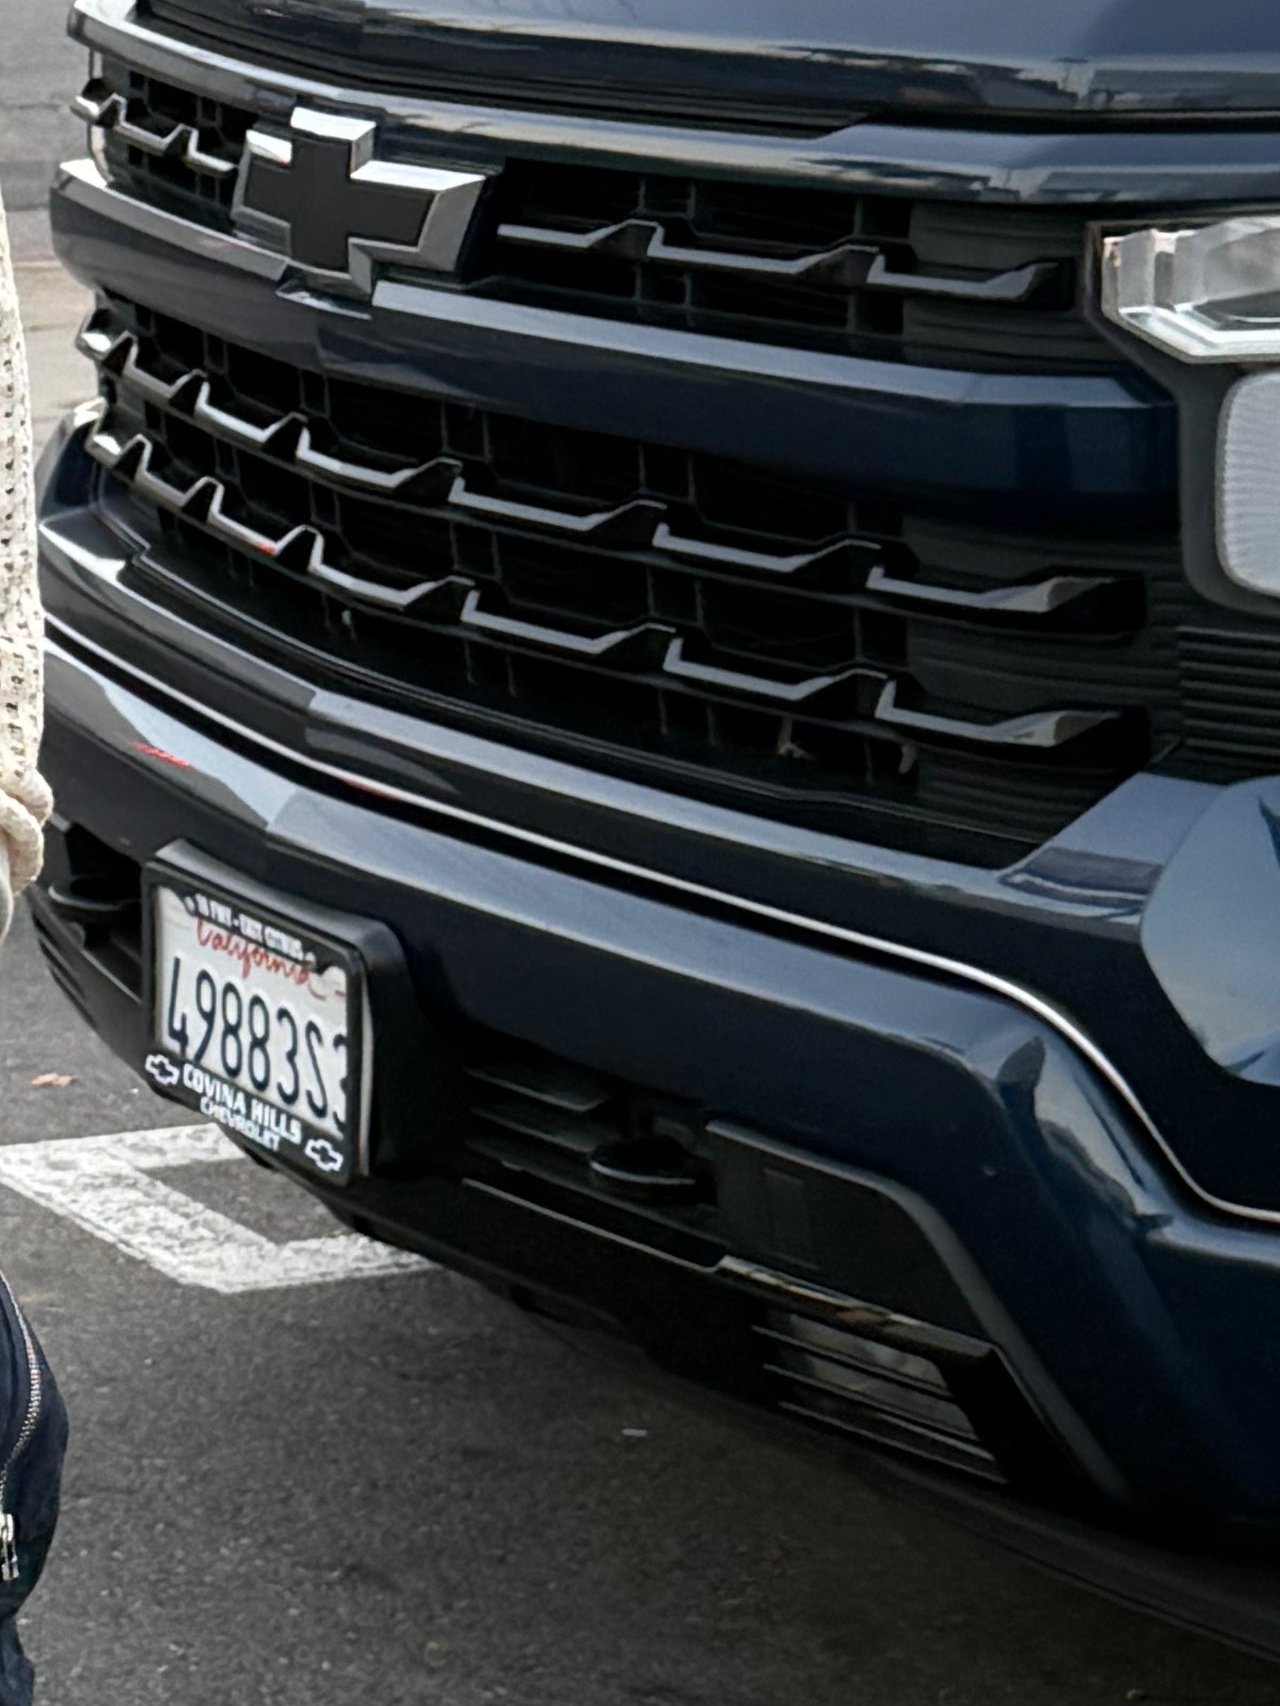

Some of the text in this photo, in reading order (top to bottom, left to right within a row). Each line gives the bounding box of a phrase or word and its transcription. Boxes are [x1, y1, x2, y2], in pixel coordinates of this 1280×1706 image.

[183, 1063, 303, 1145] COVINA HILLS
[200, 1096, 282, 1152] CHEVROLET
